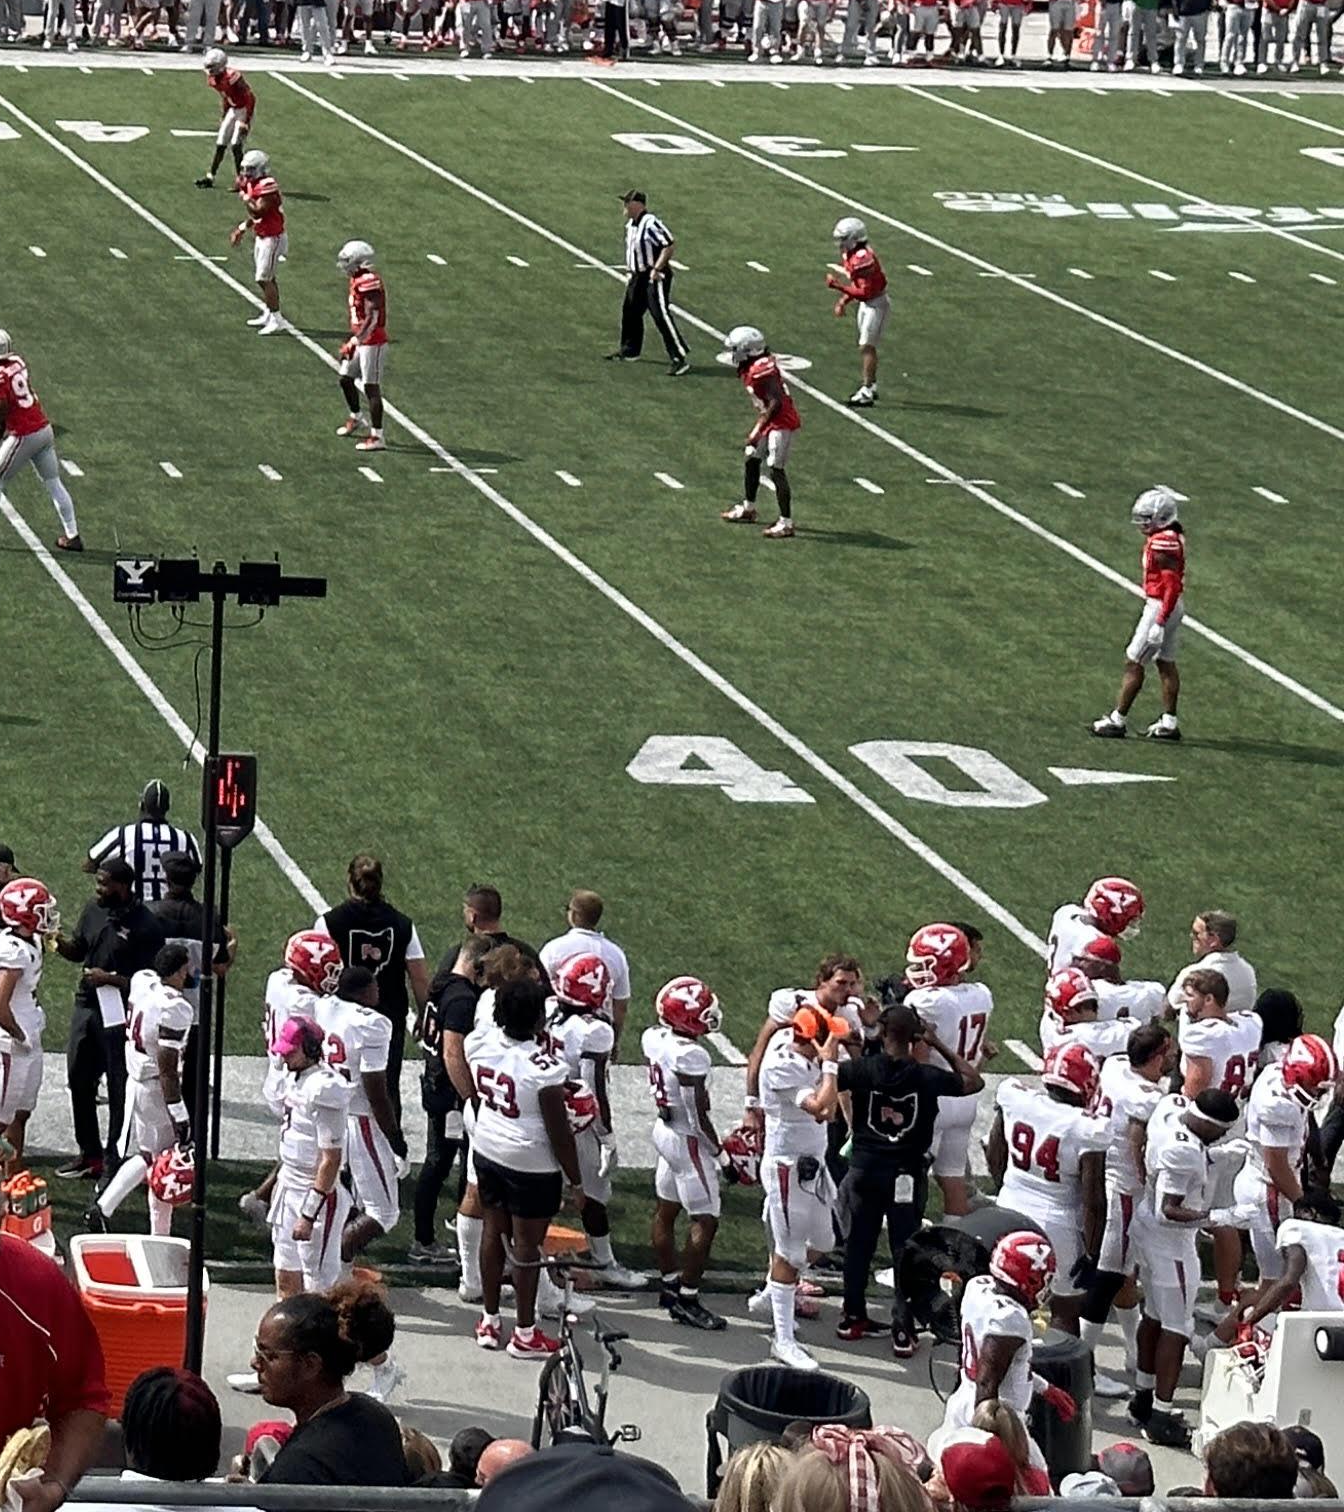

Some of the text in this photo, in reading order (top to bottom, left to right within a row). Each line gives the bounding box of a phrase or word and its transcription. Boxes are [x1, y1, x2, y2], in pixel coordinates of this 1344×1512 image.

[956, 1012, 988, 1061] 17
[475, 1067, 522, 1120] 53
[1010, 1121, 1061, 1184] 94
